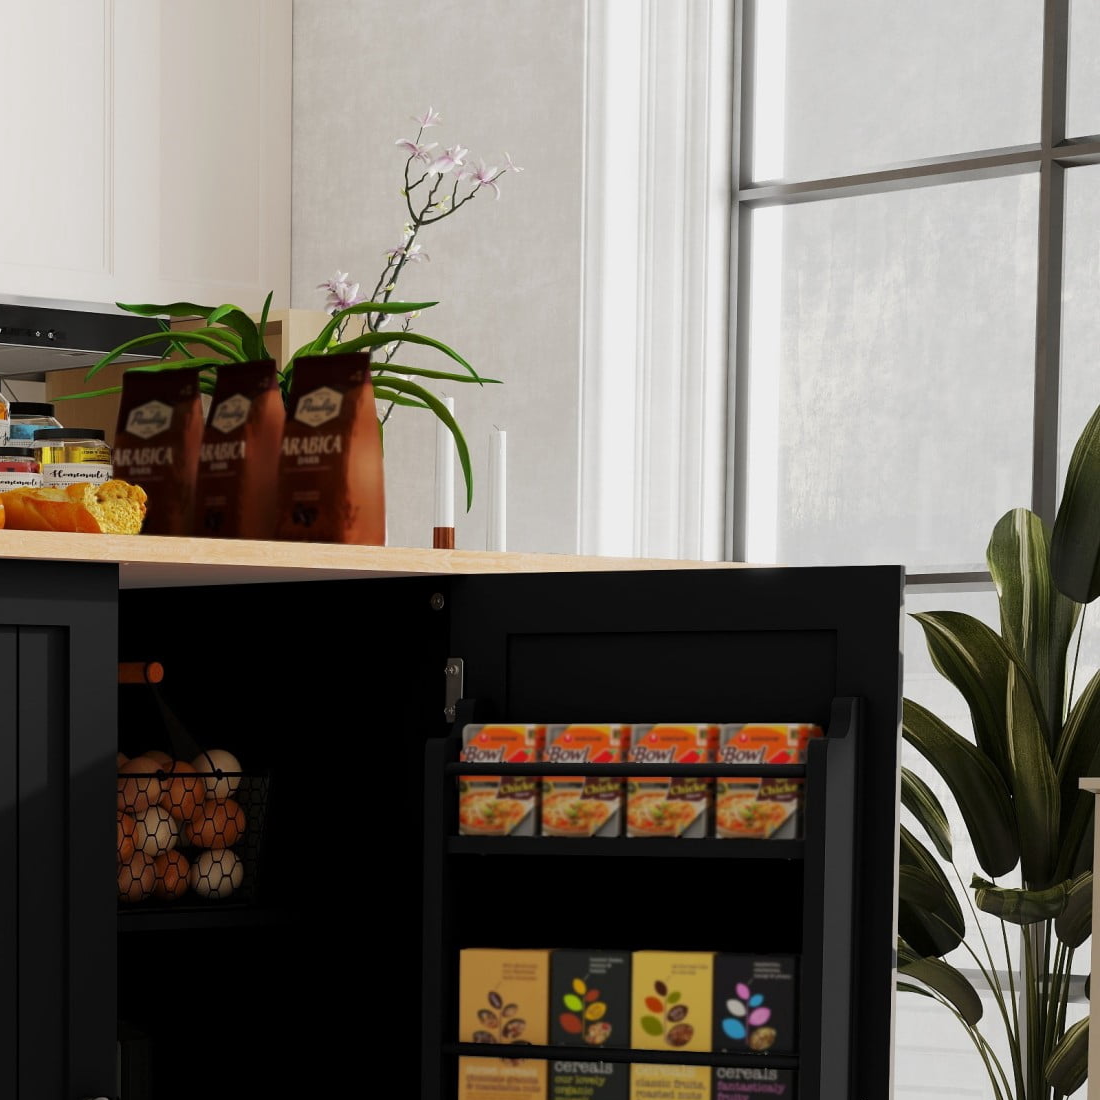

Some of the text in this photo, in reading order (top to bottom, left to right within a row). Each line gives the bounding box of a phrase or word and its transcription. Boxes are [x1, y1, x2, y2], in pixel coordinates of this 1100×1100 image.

[282, 435, 342, 456] ARABICA
[114, 447, 173, 467] ARABICA
[465, 746, 504, 762] Bowl
[548, 746, 589, 762] Bowl
[632, 746, 675, 762] Bowl
[721, 746, 766, 763] Bowl
